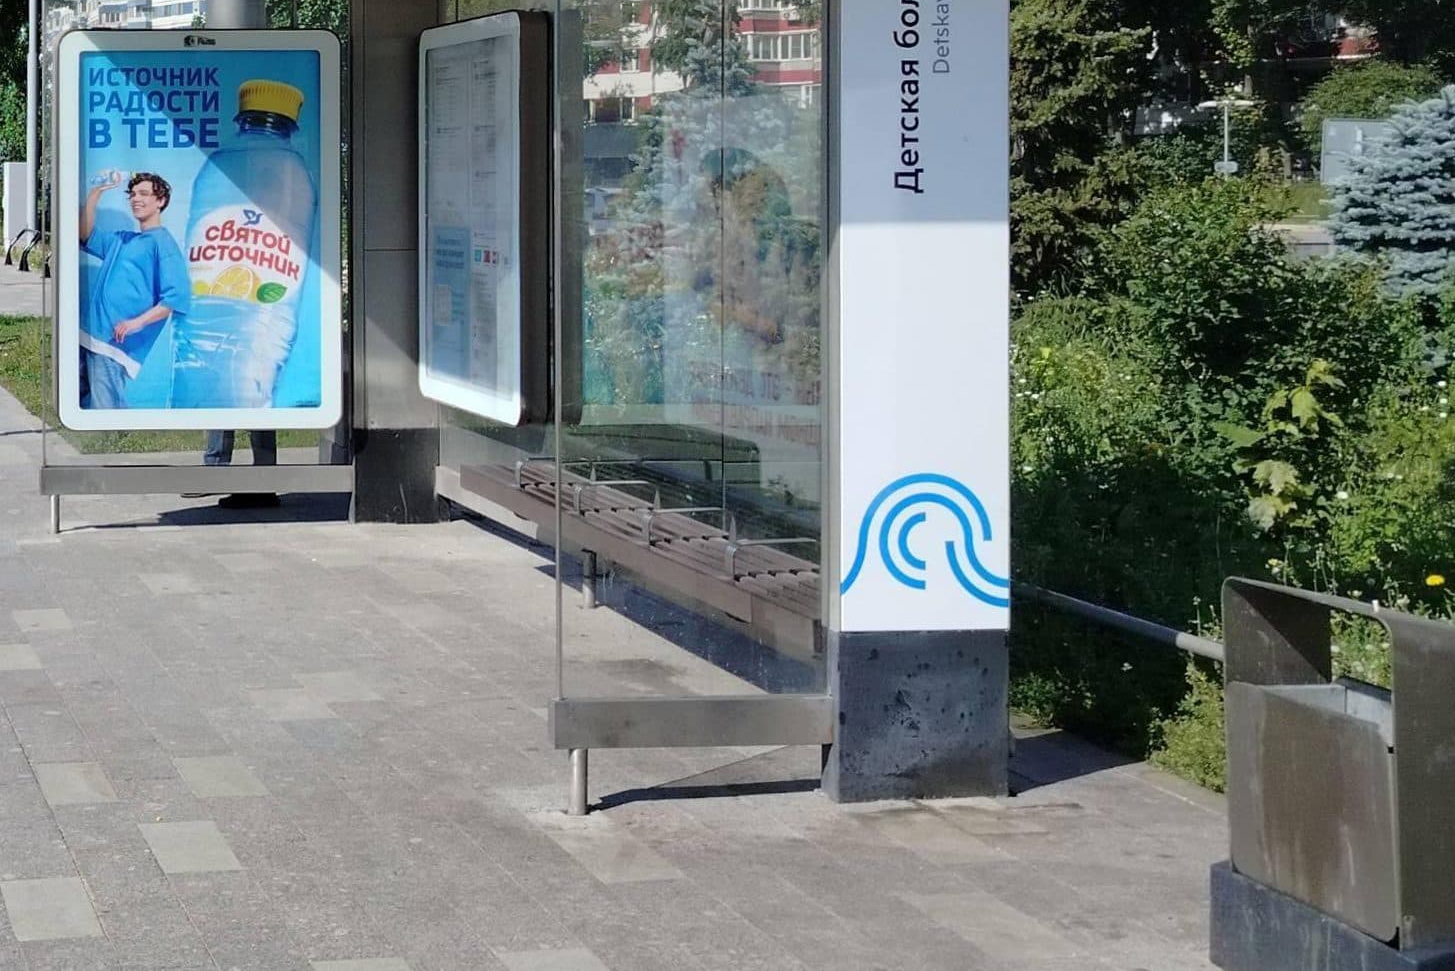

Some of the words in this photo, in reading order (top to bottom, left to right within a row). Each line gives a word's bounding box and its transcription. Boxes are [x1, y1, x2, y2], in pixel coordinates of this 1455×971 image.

[88, 67, 221, 87] ИСТОЧНИК
[88, 90, 220, 117] РАДОСТИ
[88, 118, 113, 148] В
[121, 118, 220, 148] ТЕБЕ
[894, 60, 924, 194] Детская
